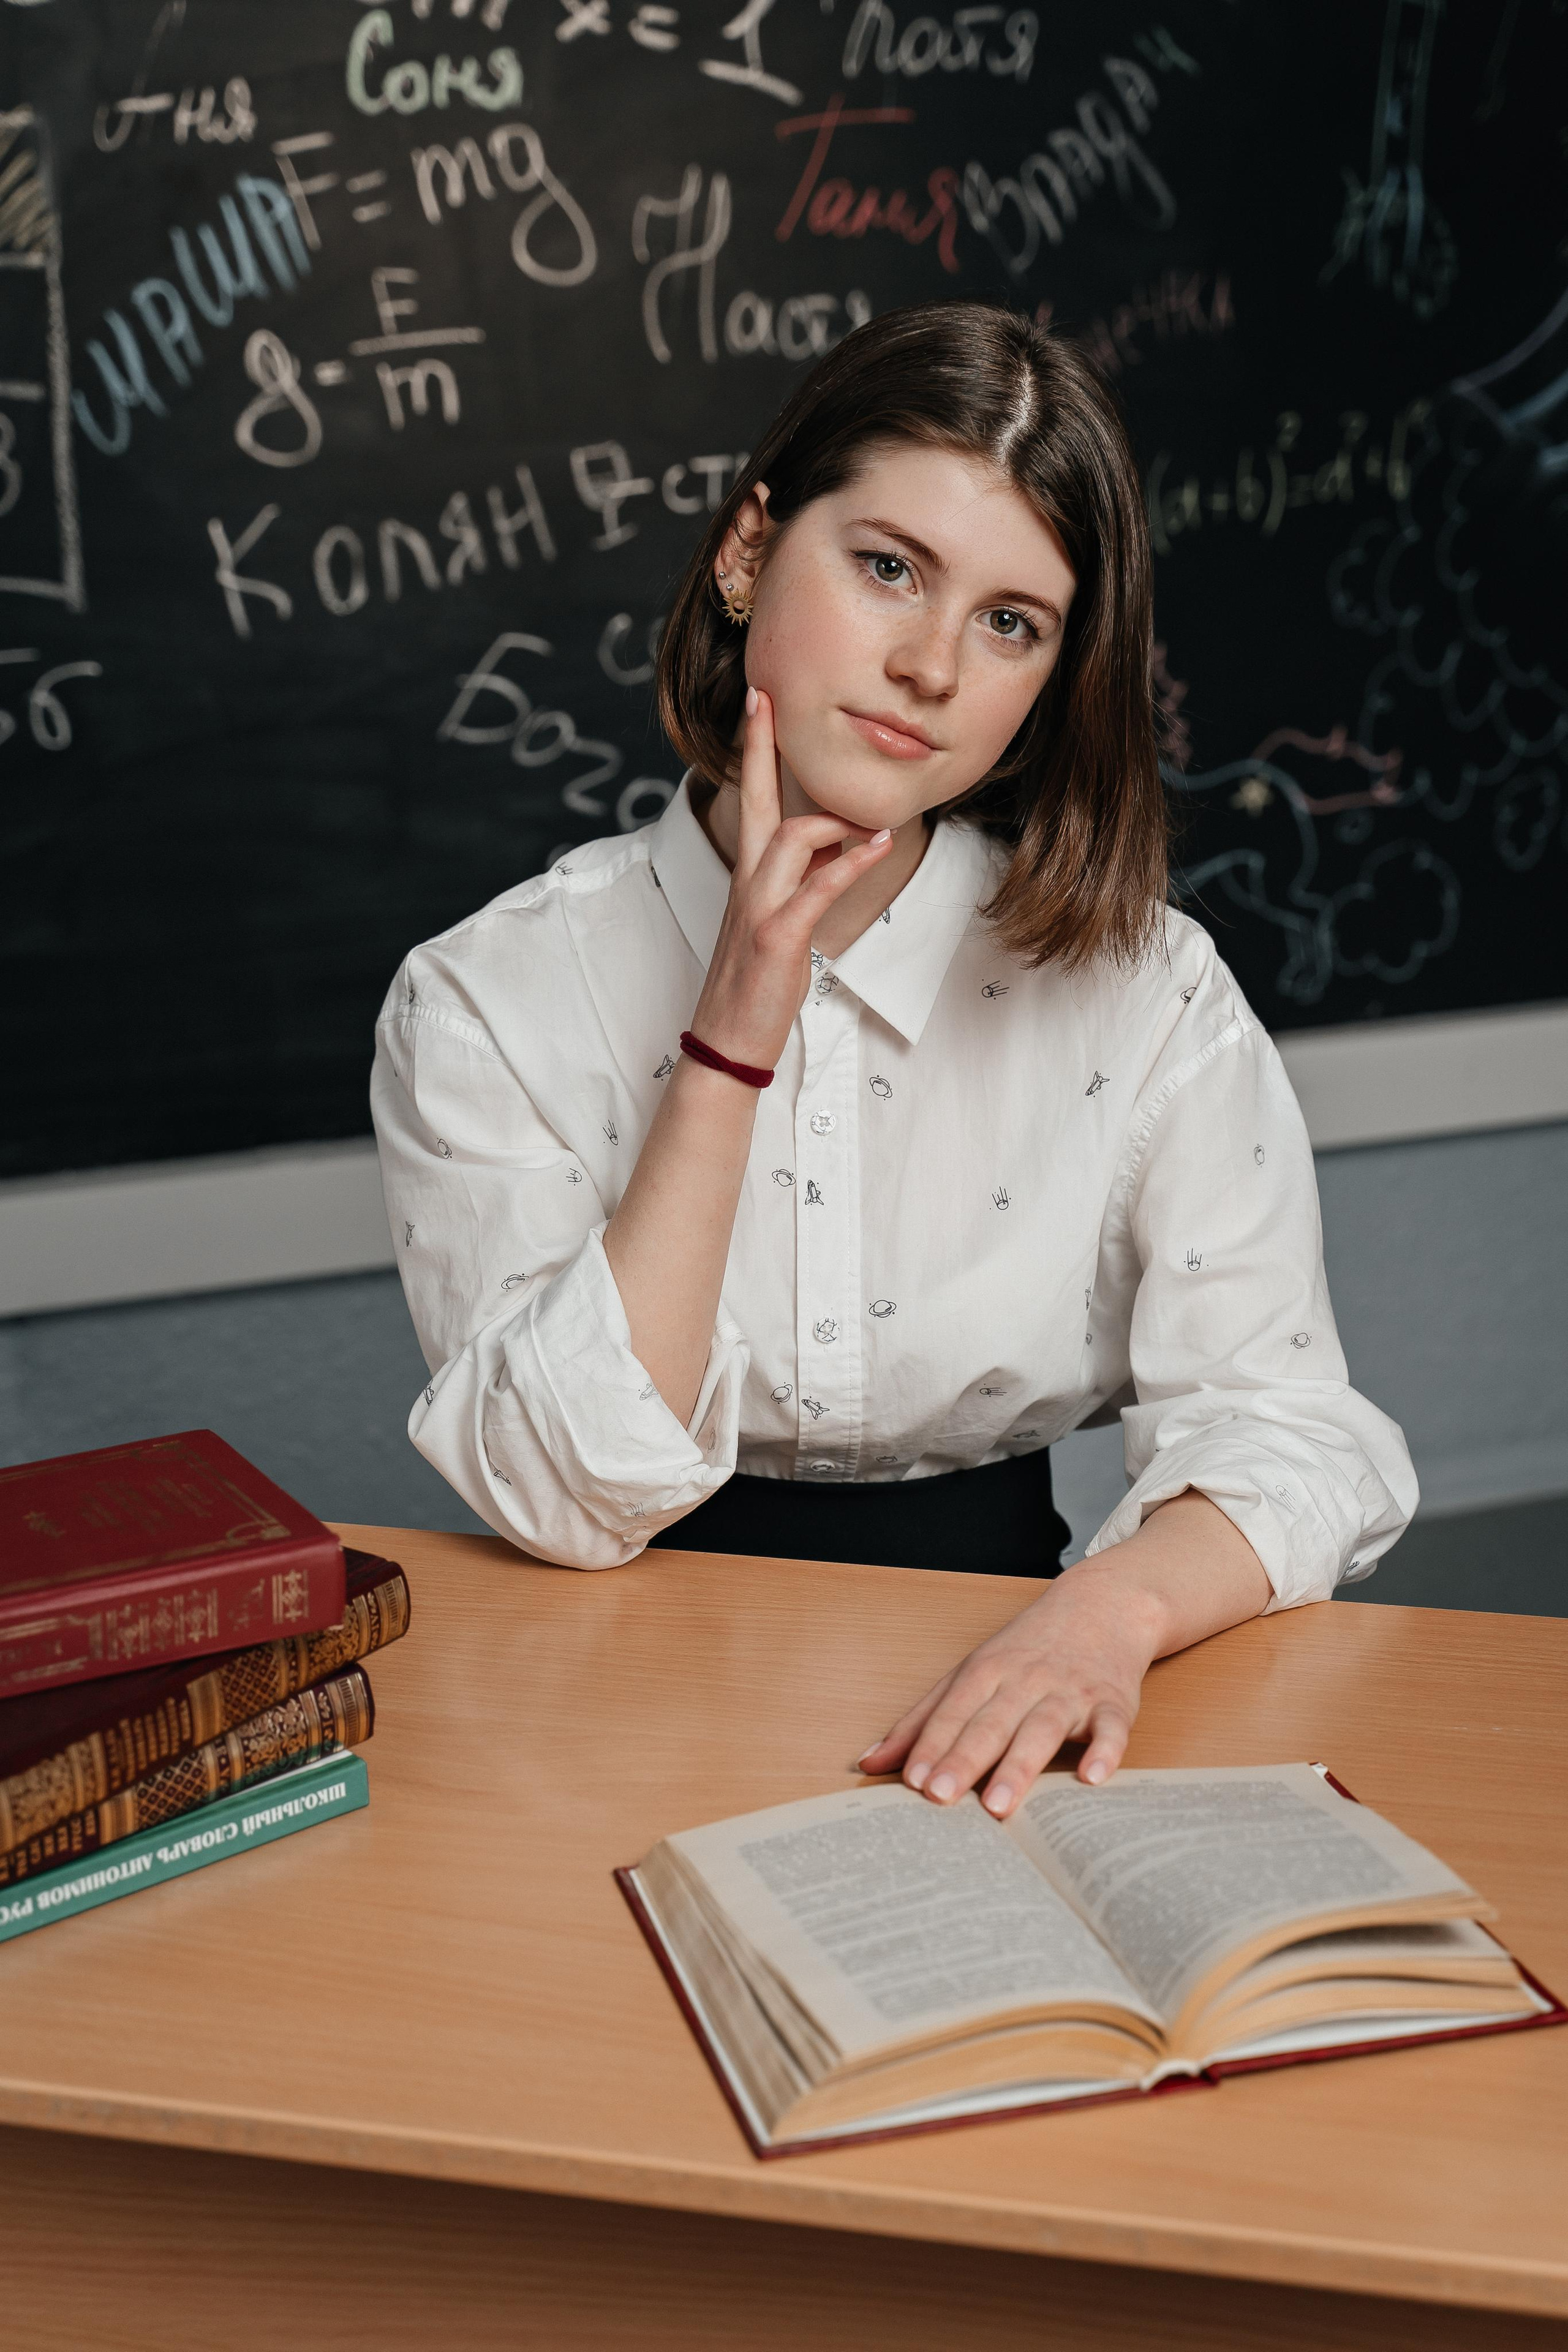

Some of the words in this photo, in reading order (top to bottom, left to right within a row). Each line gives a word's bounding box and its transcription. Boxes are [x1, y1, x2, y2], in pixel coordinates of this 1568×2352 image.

[346, 9, 524, 115] Соня
[774, 91, 963, 274] Таня
[241, 1782, 347, 1836] ШКОЛЬНЫЙ
[157, 1822, 238, 1864] СЛОВАРЬ
[36, 1853, 154, 1910] АНТОНИМОВ
